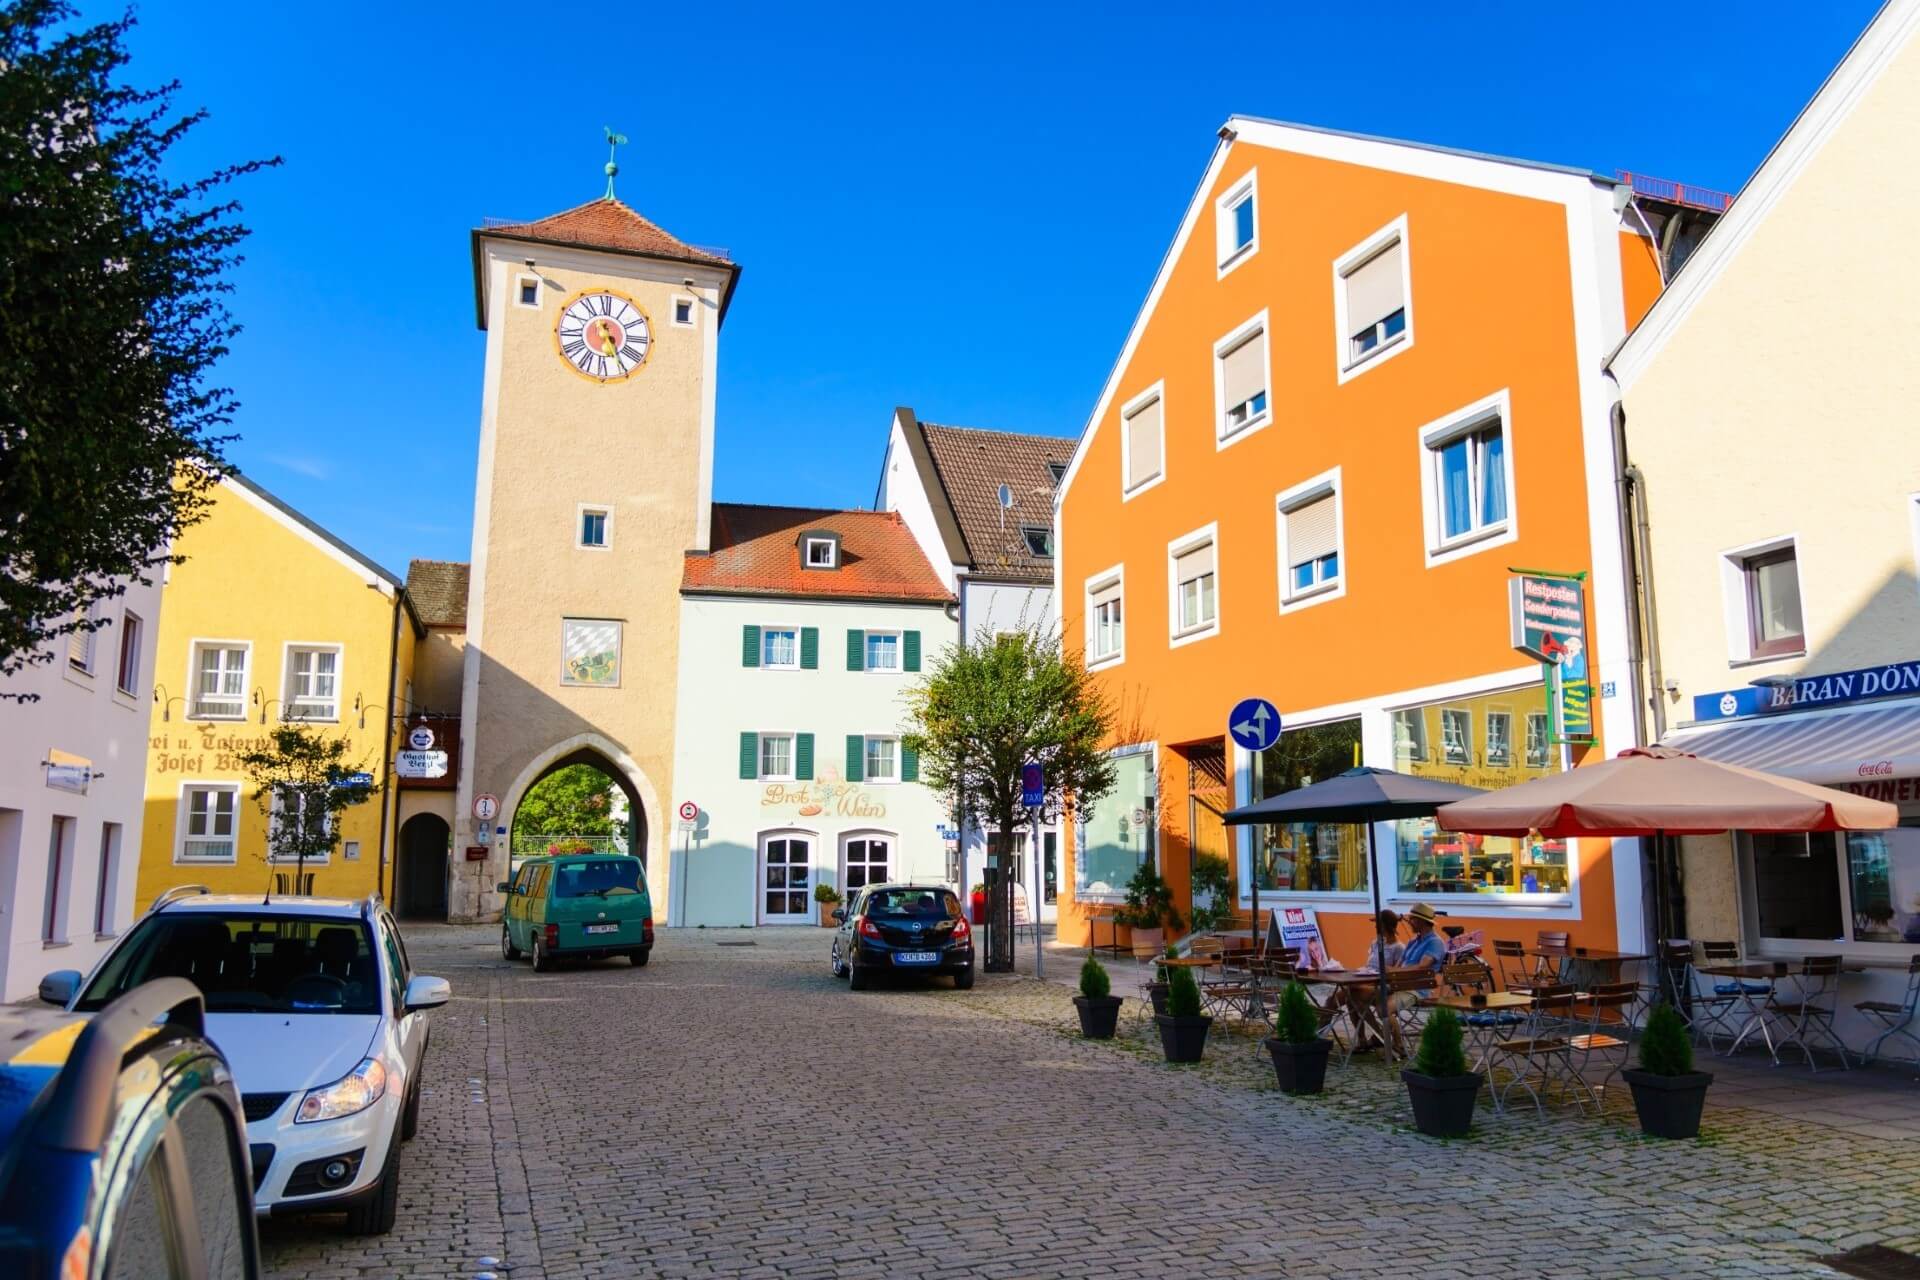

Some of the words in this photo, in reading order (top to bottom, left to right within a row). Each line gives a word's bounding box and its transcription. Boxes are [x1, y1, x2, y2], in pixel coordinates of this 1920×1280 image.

[1525, 580, 1578, 604] Restposten
[1524, 598, 1580, 621] Sonderposten
[1770, 674, 1855, 707] BARAN
[761, 784, 808, 806] Brot
[836, 789, 886, 817] Wein
[1025, 793, 1042, 801] TAXI
